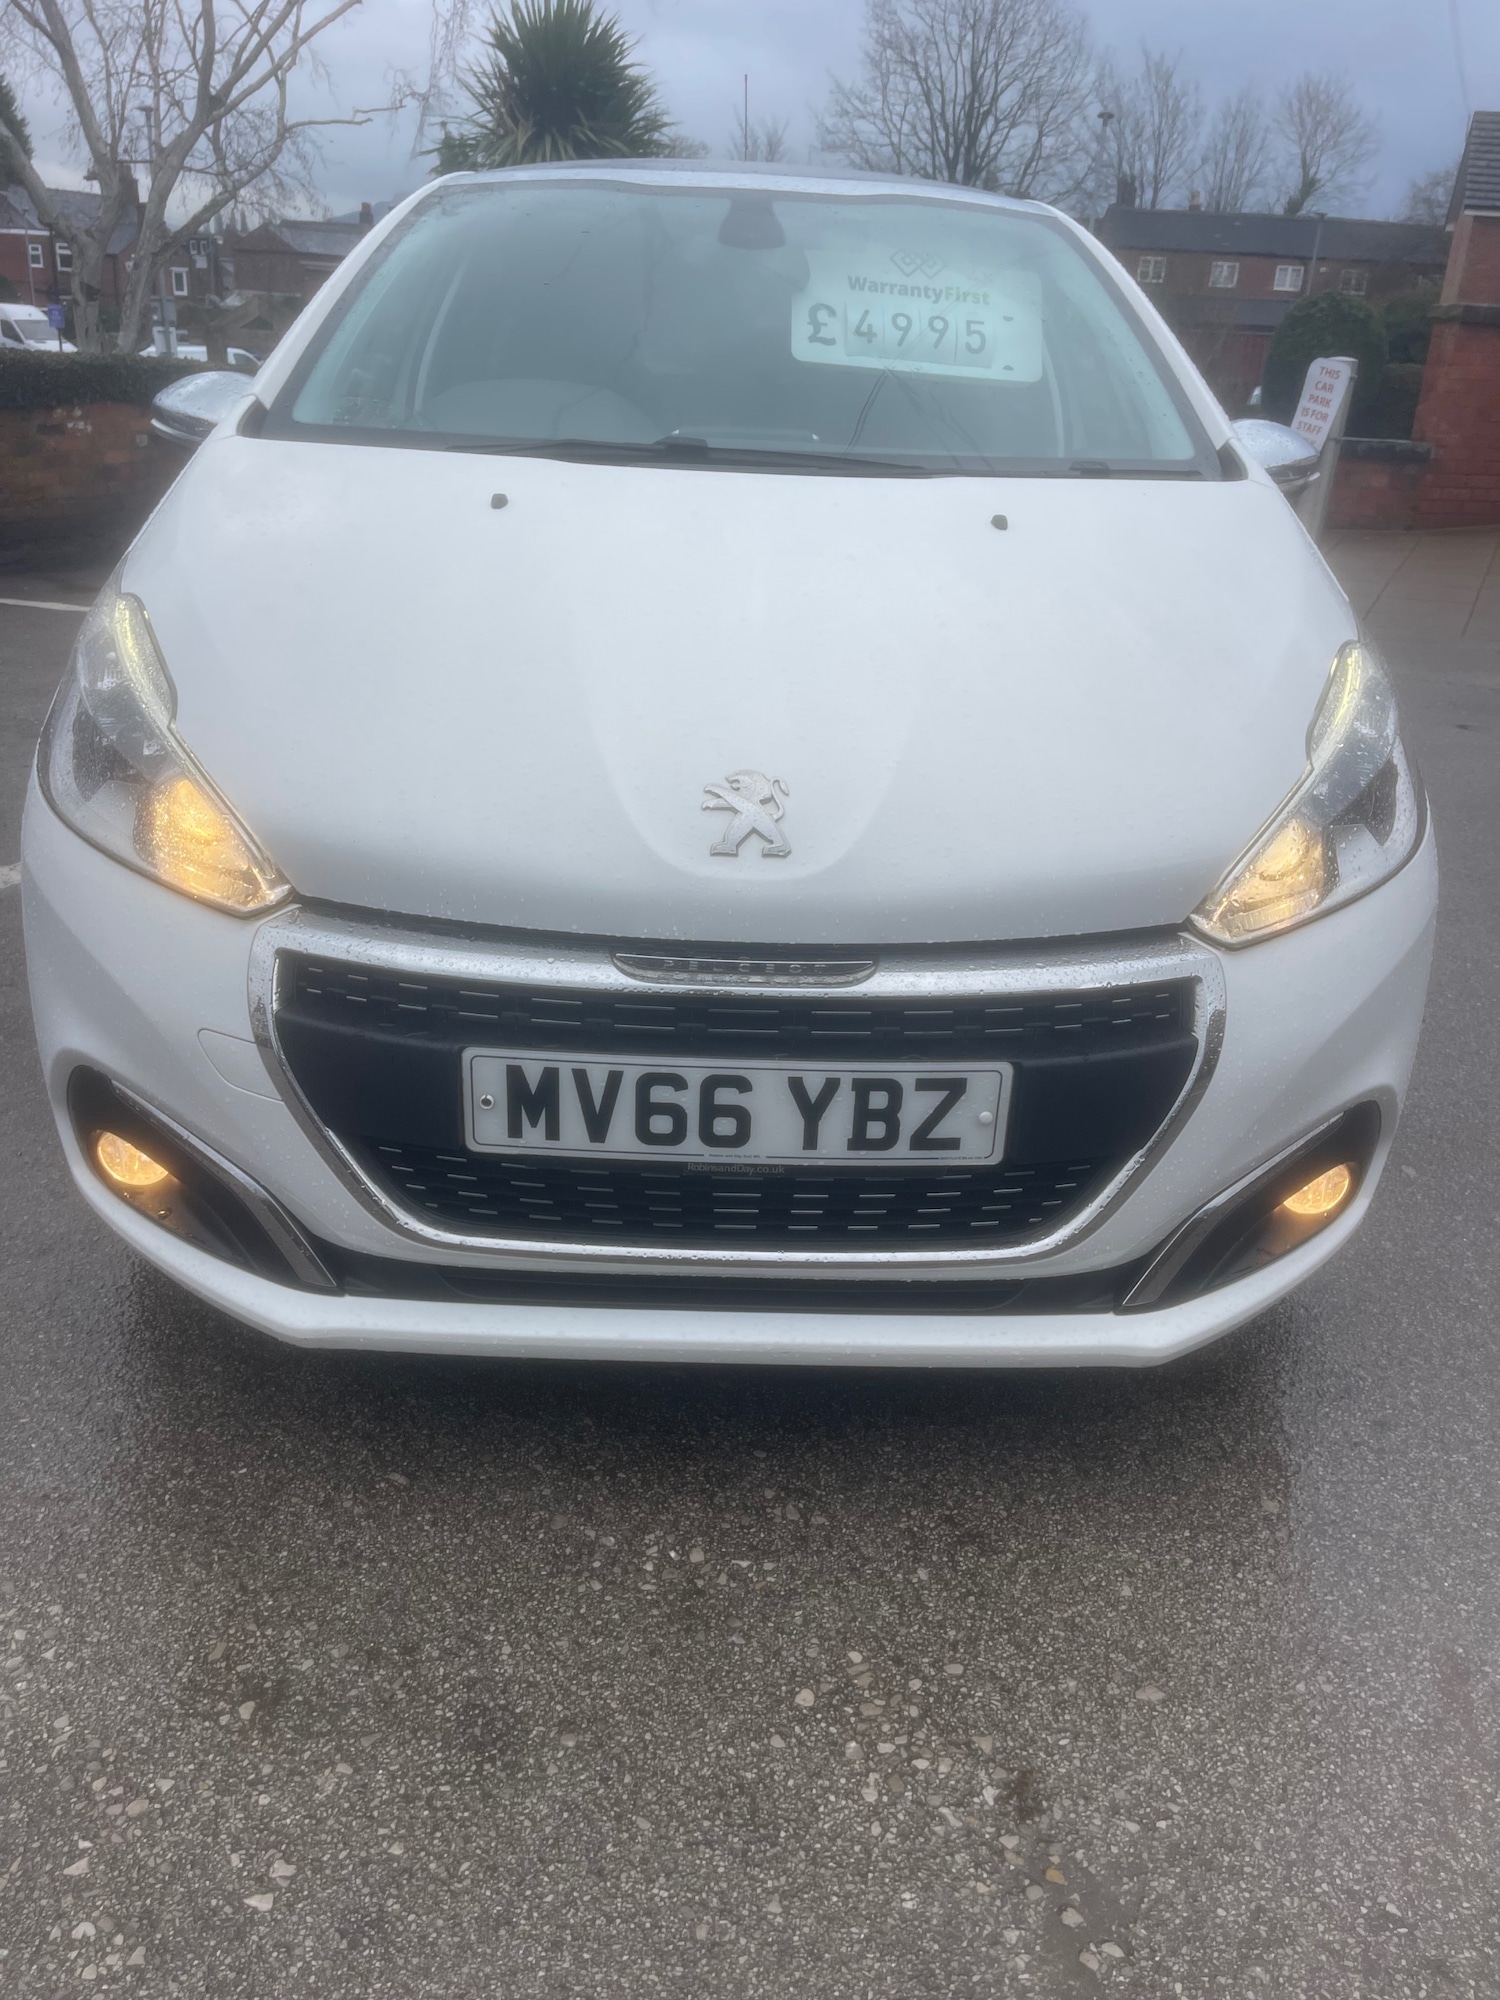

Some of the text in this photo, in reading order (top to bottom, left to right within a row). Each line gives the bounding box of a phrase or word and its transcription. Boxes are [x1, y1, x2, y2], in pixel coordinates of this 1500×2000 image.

[1320, 367, 1341, 379] THIS
[1315, 381, 1334, 393] CAR
[1308, 394, 1332, 408] PARK
[1302, 407, 1329, 422] IS FOR
[1296, 421, 1322, 435] STAFF
[505, 1065, 968, 1151] MV66 YBZ
[687, 1163, 785, 1175] RobinsandDay.co.uk
